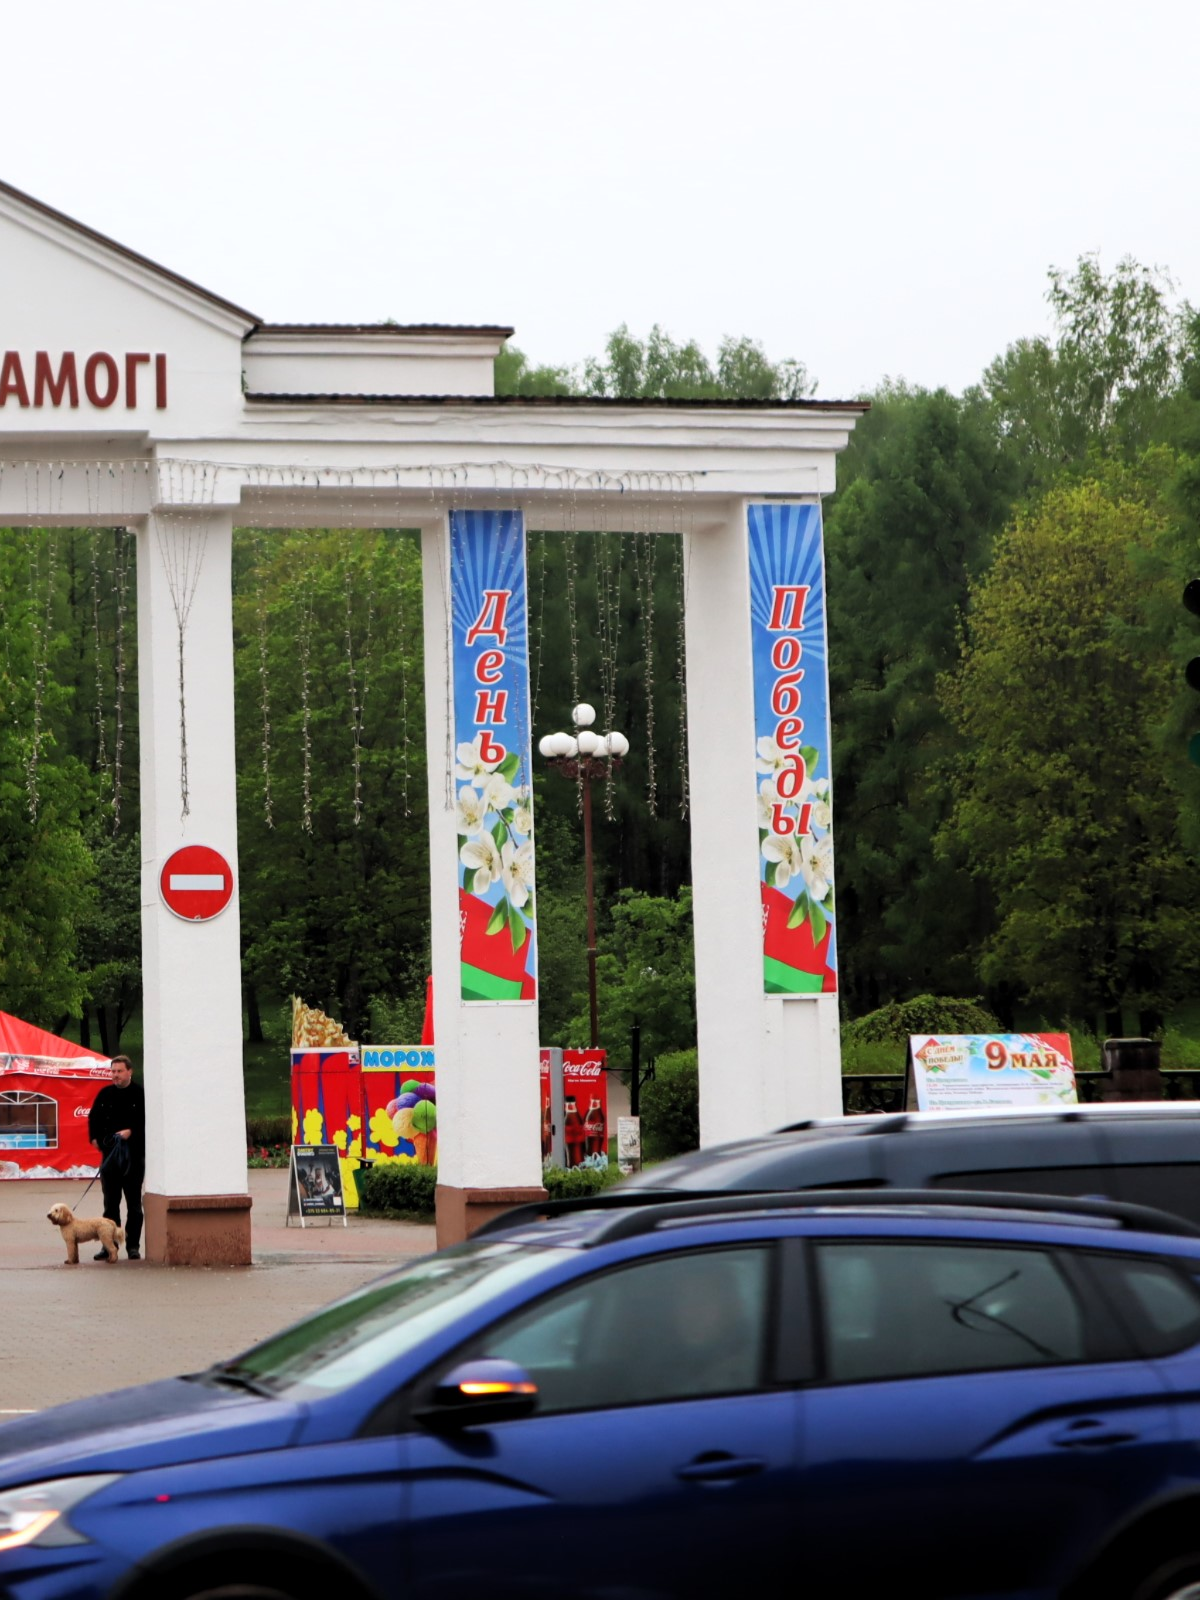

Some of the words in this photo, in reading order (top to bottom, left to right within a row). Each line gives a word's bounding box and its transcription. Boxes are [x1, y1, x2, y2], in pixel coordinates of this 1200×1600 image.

[465, 589, 512, 763] День
[767, 585, 812, 837] Победы
[985, 1041, 1008, 1070] 9
[1010, 1052, 1058, 1069] МАЯ
